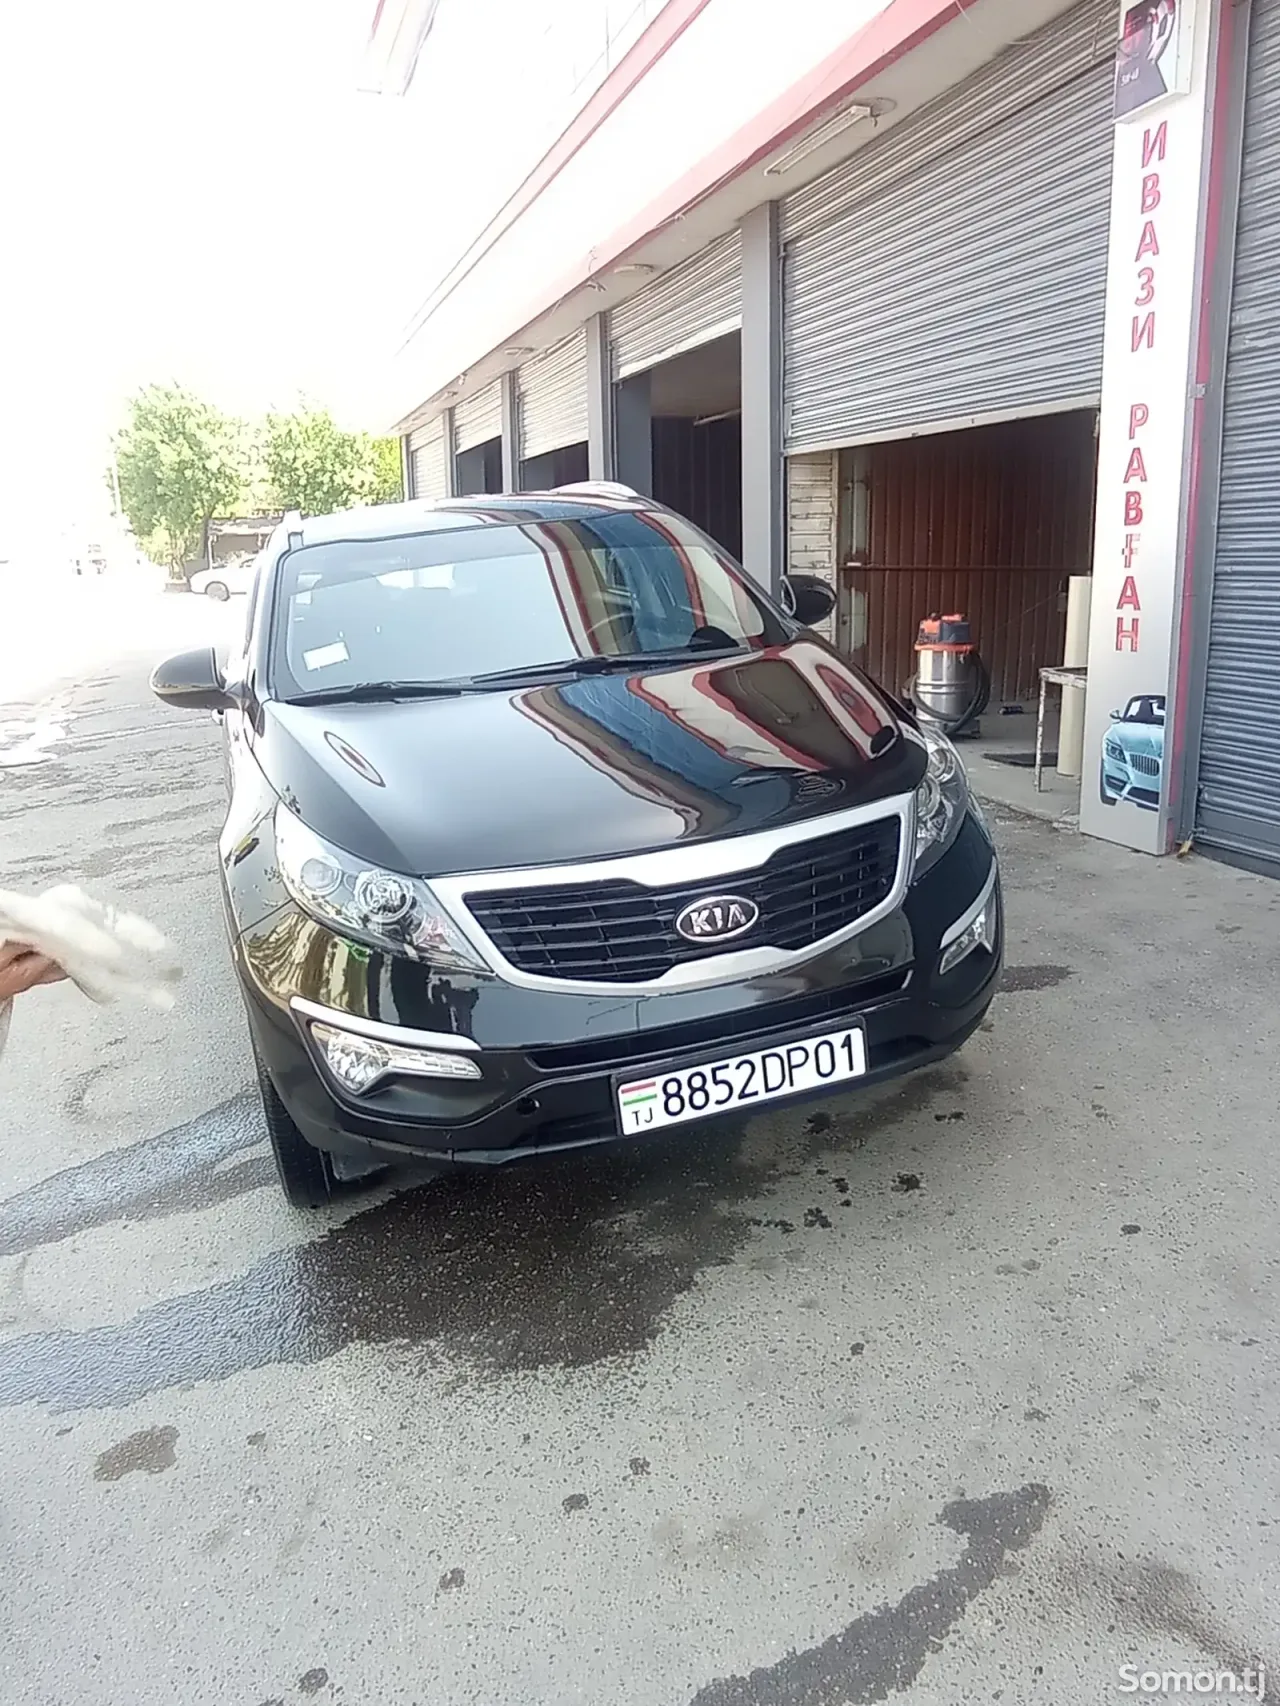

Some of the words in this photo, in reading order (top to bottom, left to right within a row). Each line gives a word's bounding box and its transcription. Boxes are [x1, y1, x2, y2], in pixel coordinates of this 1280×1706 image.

[1131, 120, 1168, 353] ИВАЗИ
[689, 903, 747, 934] KIA
[661, 1033, 855, 1117] 8852DP01
[631, 1107, 654, 1127] TJ
